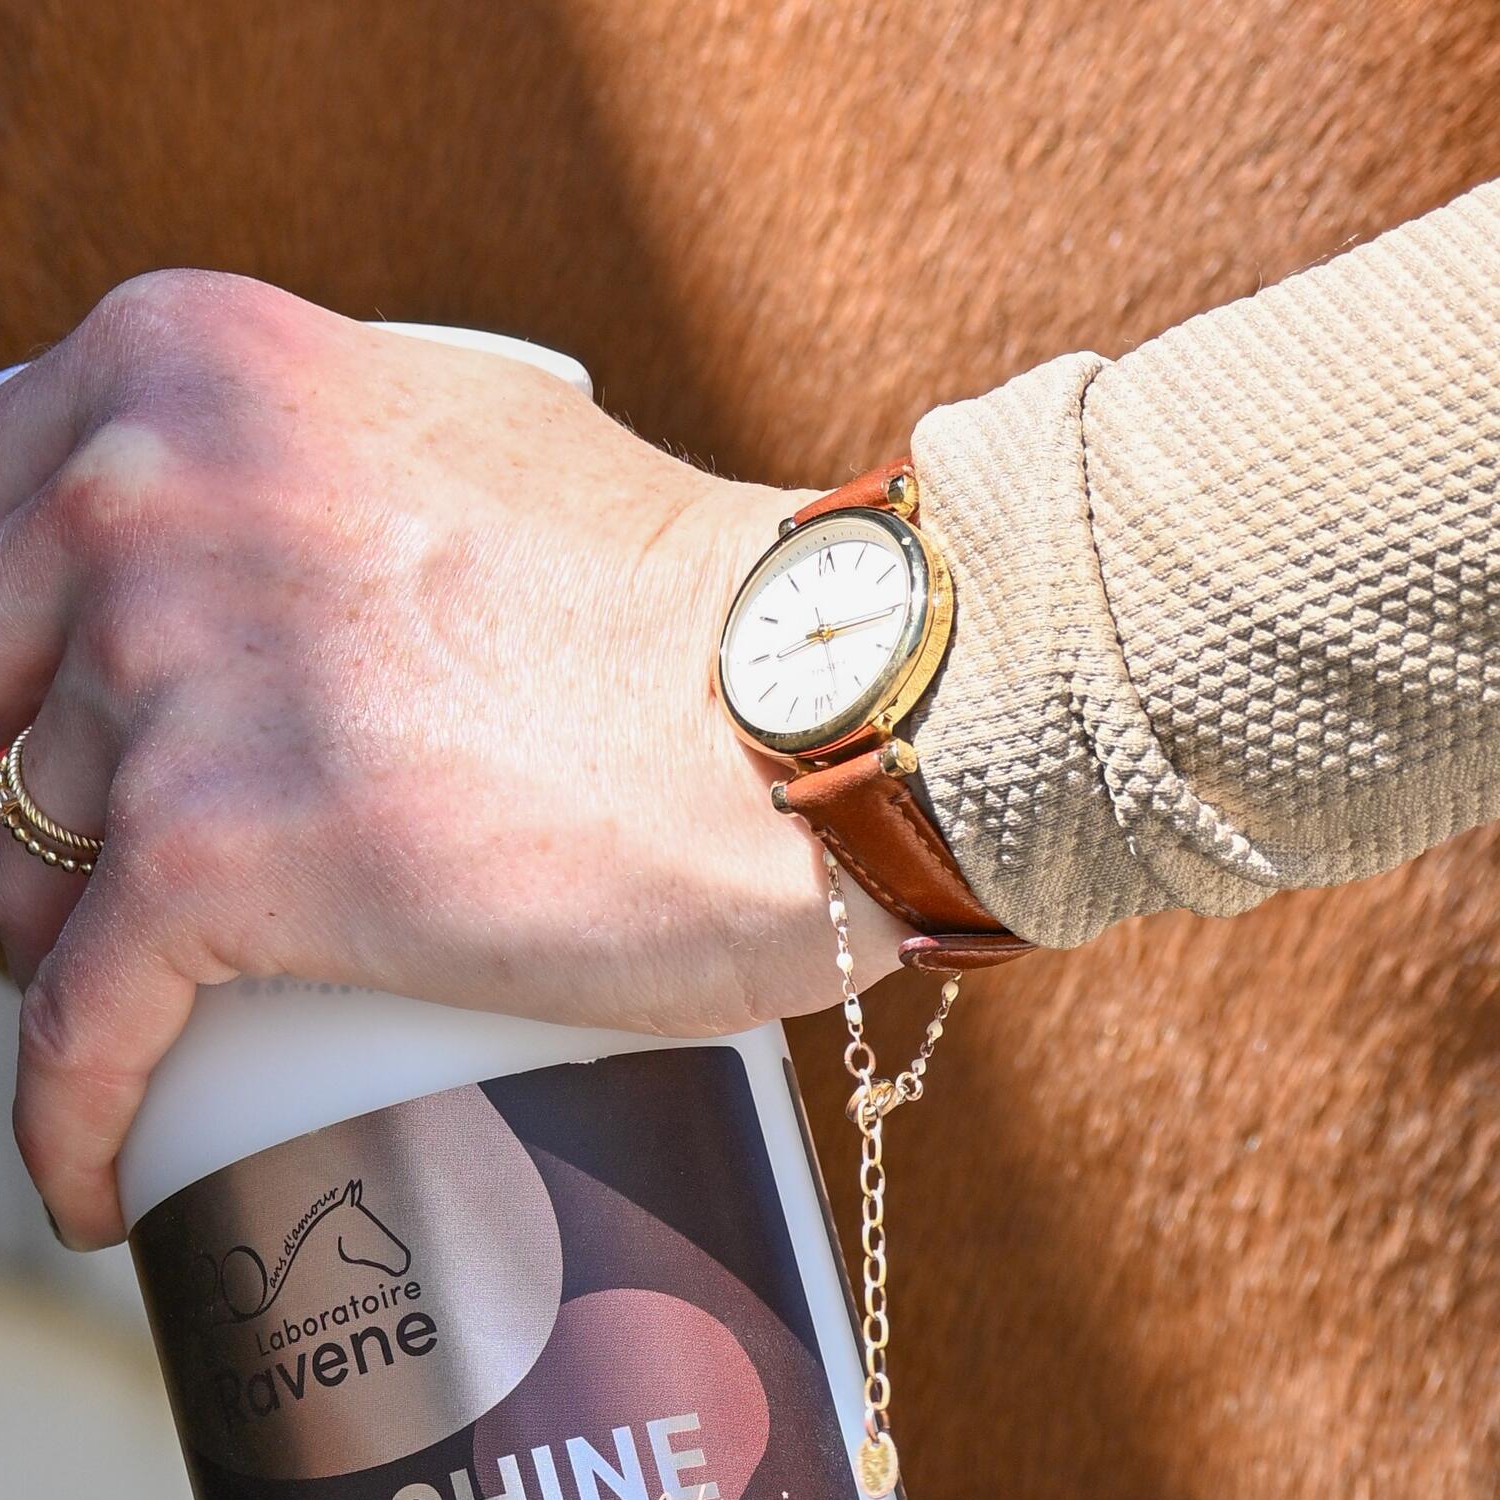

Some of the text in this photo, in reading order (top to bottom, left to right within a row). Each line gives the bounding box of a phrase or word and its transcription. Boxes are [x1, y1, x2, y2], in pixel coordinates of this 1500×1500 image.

[268, 1257, 287, 1288] ans
[283, 1187, 339, 1255] d'amour
[212, 1311, 438, 1424] Ravene
[256, 1280, 422, 1357] Laboratoire
